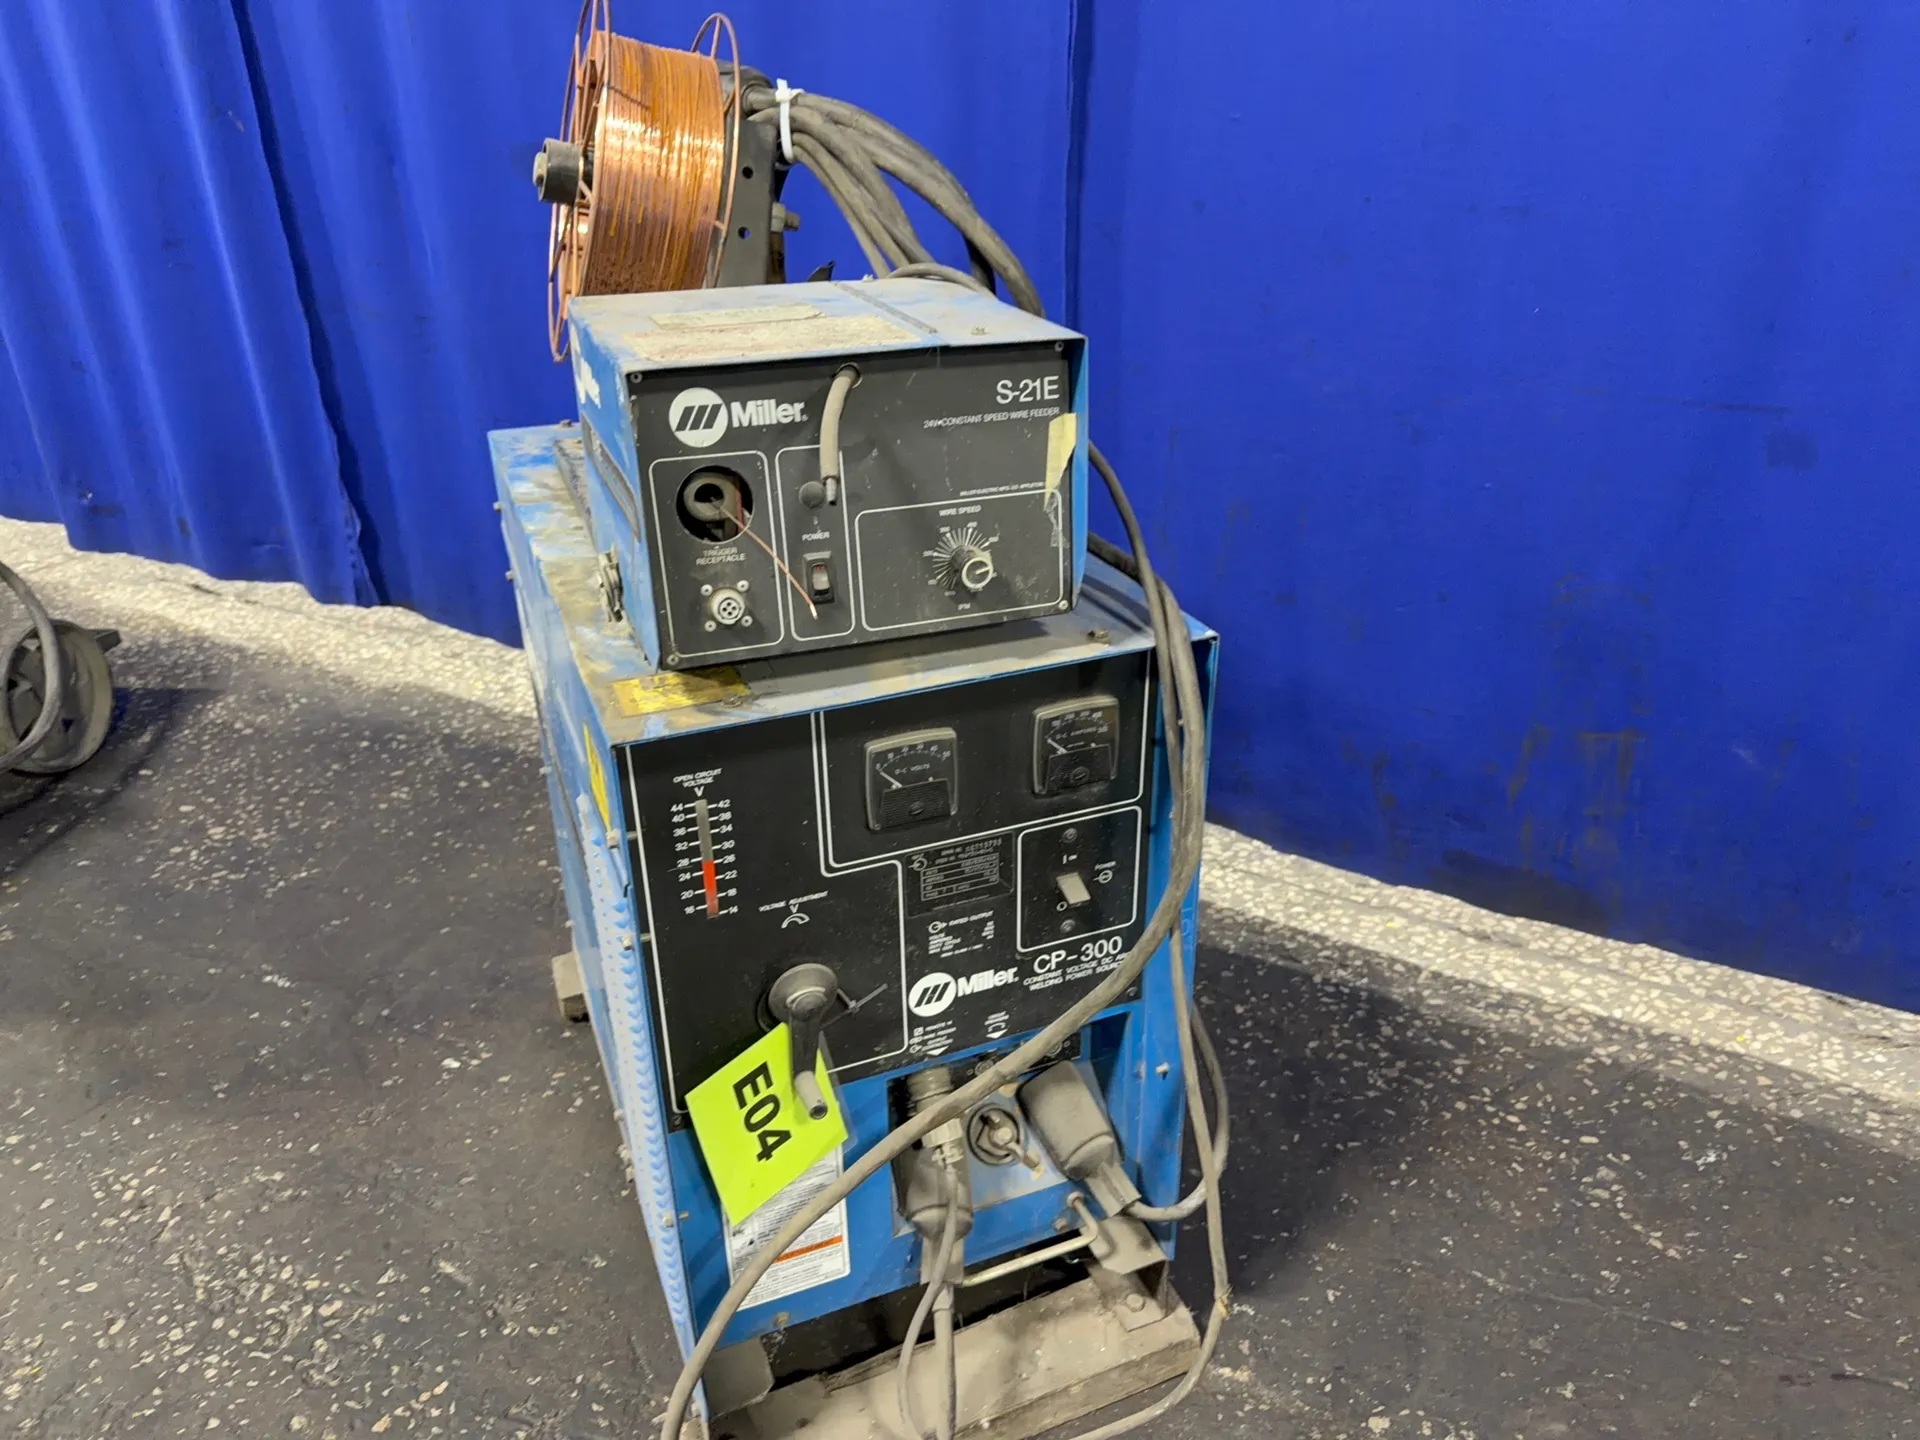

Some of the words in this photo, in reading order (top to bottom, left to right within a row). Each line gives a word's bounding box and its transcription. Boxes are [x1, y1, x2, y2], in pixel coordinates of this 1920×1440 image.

[996, 375, 1060, 404] S-21E
[730, 399, 807, 428] Miller
[983, 411, 1009, 422] SPEED
[1010, 409, 1029, 419] WIRE
[1030, 406, 1060, 418] FEEDER
[939, 508, 957, 516] WIRE
[958, 505, 982, 514] SPEED
[802, 531, 830, 541] POWER
[703, 547, 738, 557] TRIGGER
[696, 552, 746, 565] RECEPTACLE
[673, 774, 694, 783] OPEN
[694, 768, 722, 779] CIRCUIT
[682, 777, 714, 788] VOLTAGE
[670, 802, 683, 812] 44
[717, 799, 731, 808] 42
[671, 813, 685, 823] 40
[718, 811, 732, 821] 38
[720, 823, 733, 834] 34
[675, 841, 688, 851] 32
[721, 839, 735, 850] 30
[678, 872, 691, 882] 24
[724, 869, 738, 880] 22
[680, 889, 694, 900] 20
[758, 900, 787, 912] VOLTAGE
[788, 890, 828, 905] ADJUSTMENT
[1033, 935, 1122, 974] CP-300
[1023, 969, 1063, 986] CONSTANT
[1066, 959, 1098, 973] VOLTAGE
[1101, 955, 1113, 965] DC
[1029, 976, 1063, 991] WELDING
[1065, 968, 1093, 981] POWER
[1096, 960, 1124, 973] SOURC
[957, 966, 1019, 997] Miller
[733, 1061, 792, 1162] E04
